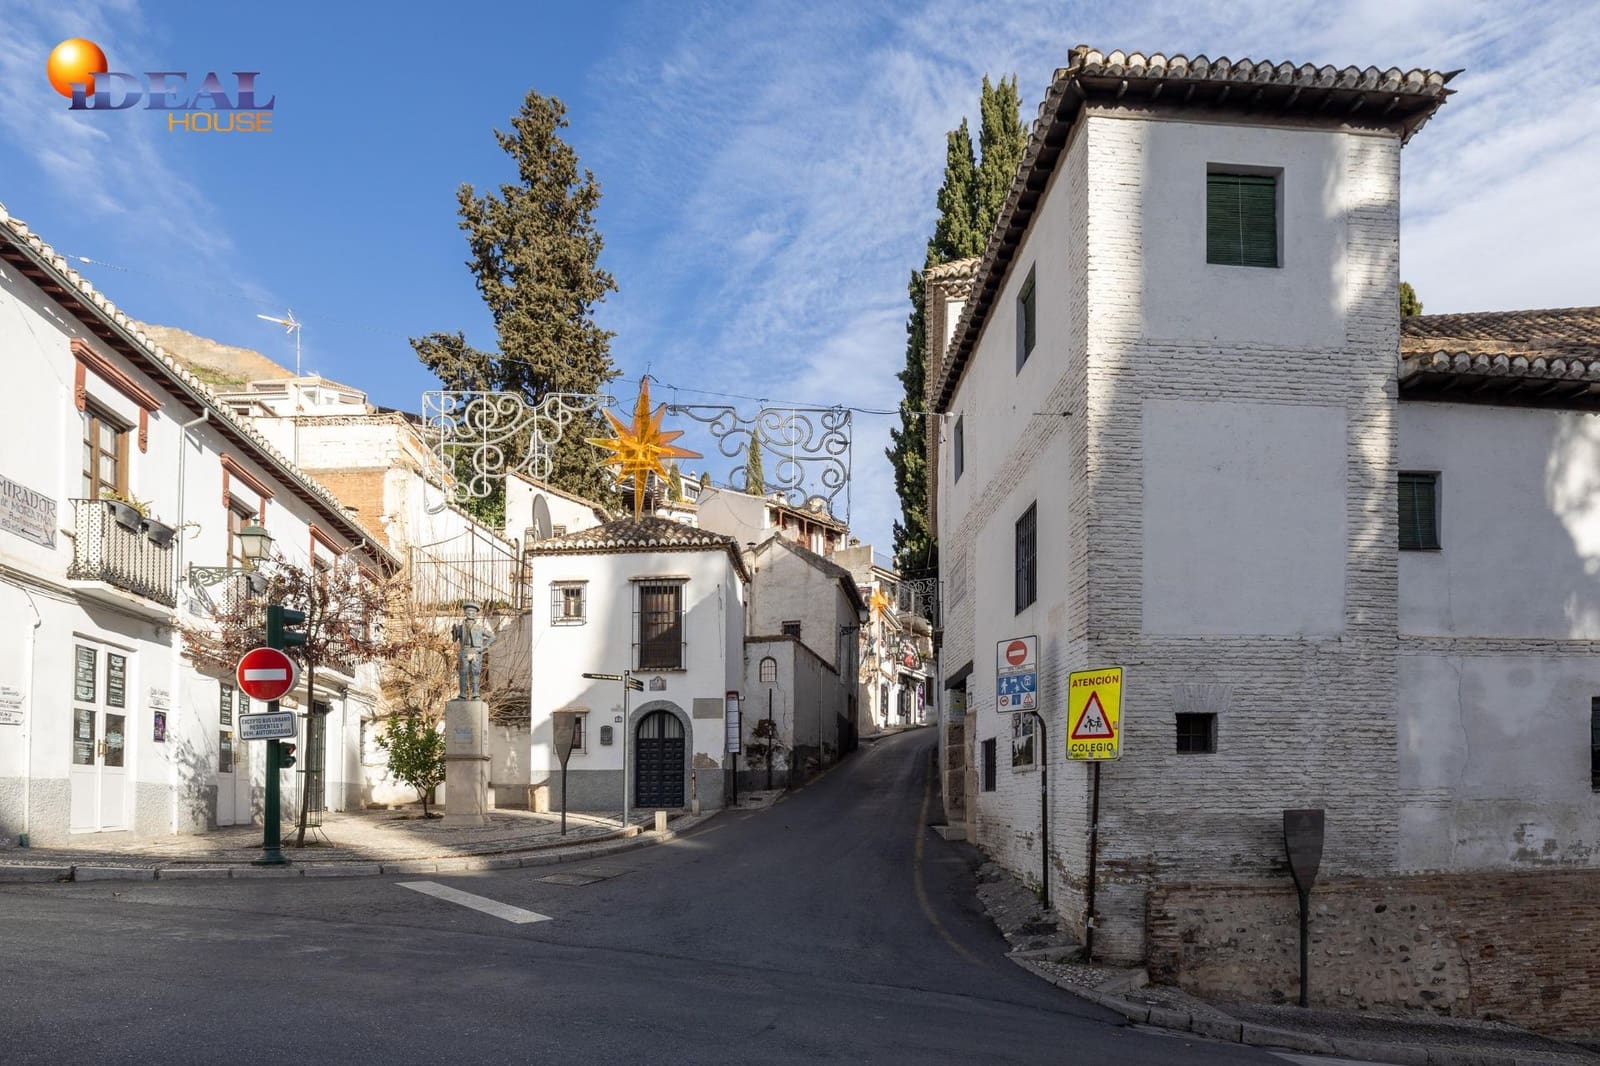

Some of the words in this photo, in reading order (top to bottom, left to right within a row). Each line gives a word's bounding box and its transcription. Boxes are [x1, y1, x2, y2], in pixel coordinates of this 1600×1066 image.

[0, 479, 56, 518] MIRADOR
[1072, 674, 1119, 688] ATENCIÓN
[1071, 742, 1114, 752] COLEGIO
